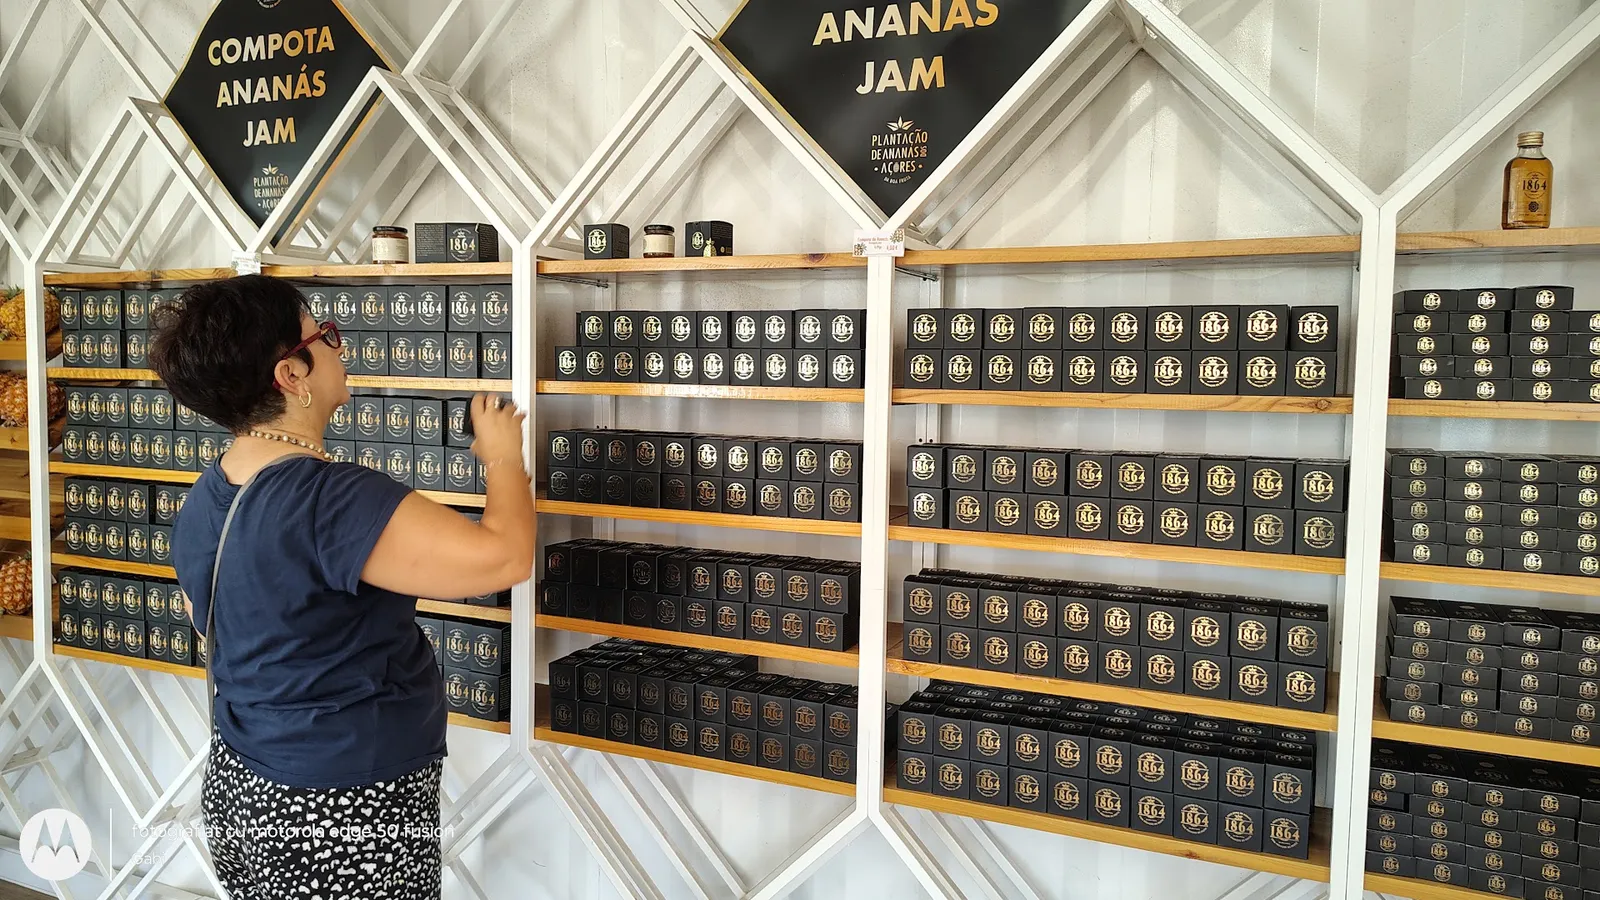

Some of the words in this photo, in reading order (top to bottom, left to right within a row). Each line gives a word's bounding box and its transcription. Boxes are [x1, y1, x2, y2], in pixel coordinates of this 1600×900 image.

[208, 25, 335, 66] COMPOTA
[855, 55, 945, 95] JAM
[217, 64, 326, 108] ANANÁS
[243, 117, 296, 147] JAM
[872, 129, 928, 146] PLANTAÇÃO
[1522, 180, 1546, 190] 1864
[450, 238, 475, 251] 1864
[61, 304, 77, 315] 1864
[102, 303, 118, 315] 1864
[126, 303, 144, 314] 1864
[334, 302, 356, 314] 1864
[361, 302, 385, 314] 1864
[391, 302, 415, 315] 1864
[418, 302, 442, 314] 1864
[451, 302, 476, 315] 1864
[482, 302, 508, 314] 1864
[913, 322, 937, 334] 1864
[951, 322, 975, 334] 1864
[990, 322, 1015, 334] 1864
[1029, 322, 1054, 334] 1864
[1069, 321, 1095, 334] 1864
[1111, 320, 1138, 333] 1864
[1155, 320, 1183, 333] 1864
[1199, 320, 1229, 334] 1864
[1247, 319, 1277, 333] 1864
[1298, 320, 1328, 335] 1864
[100, 343, 118, 354] 1864
[127, 343, 145, 354] 1864
[362, 347, 385, 359] 1864
[392, 347, 415, 360] 1864
[418, 348, 441, 360] 1864
[450, 348, 473, 361] 1864
[483, 349, 507, 362] 1864
[948, 362, 973, 375] 1864
[1028, 363, 1054, 376] 1864
[1069, 363, 1095, 376] 1864
[1154, 364, 1182, 378] 1864
[1198, 365, 1228, 379] 1864
[1246, 365, 1277, 379] 1864
[1295, 365, 1326, 379] 1864
[68, 401, 86, 412] 1864
[106, 401, 125, 412] 1864
[152, 403, 171, 415] 1864
[357, 412, 380, 424] 1864
[387, 414, 409, 426] 1864
[416, 416, 439, 429] 1864
[64, 439, 82, 450] 1864
[130, 442, 149, 454] 1864
[174, 445, 193, 457] 1864
[387, 459, 411, 472] 1864
[417, 460, 441, 474] 1864
[448, 463, 472, 477] 1864
[912, 460, 935, 472] 1864
[992, 464, 1016, 476] 1864
[1032, 465, 1057, 478] 1864
[1076, 467, 1102, 481] 1864
[1118, 470, 1145, 483] 1864
[1161, 471, 1189, 485] 1864
[1206, 473, 1236, 488] 1864
[1252, 476, 1283, 490] 1864
[1303, 479, 1334, 494] 1864
[107, 495, 124, 508] 1864
[129, 497, 146, 510] 1864
[157, 499, 174, 511] 1864
[995, 505, 1019, 518] 1864
[1034, 508, 1060, 521] 1864
[1075, 511, 1101, 524] 1864
[1117, 512, 1144, 526] 1864
[1160, 515, 1188, 530] 1864
[1205, 518, 1234, 534] 1864
[129, 536, 147, 549] 1864
[79, 586, 97, 599] 1864
[123, 593, 141, 605] 1864
[147, 596, 165, 608] 1864
[984, 602, 1009, 615] 1864
[1023, 606, 1048, 619] 1864
[1064, 610, 1089, 623] 1864
[1104, 614, 1131, 629] 1864
[1147, 618, 1175, 633] 1864
[124, 631, 142, 645] 1864
[1191, 624, 1220, 639] 1864
[1238, 628, 1267, 643] 1864
[171, 638, 188, 651] 1864
[447, 637, 470, 653] 1864
[474, 642, 498, 658] 1864
[984, 643, 1009, 656] 1864
[1192, 667, 1221, 683] 1864
[446, 682, 469, 698] 1864
[1285, 678, 1316, 694] 1864
[471, 688, 495, 705] 1864
[976, 735, 1000, 748] 1864
[1015, 740, 1040, 754] 1864
[1055, 746, 1080, 760] 1864
[1137, 759, 1165, 774] 1864
[1181, 767, 1209, 782] 1864
[1226, 774, 1255, 789] 1864
[1272, 780, 1302, 795] 1864
[1054, 787, 1079, 801] 1864
[1225, 819, 1254, 834] 1864
[1270, 826, 1299, 841] 1864
